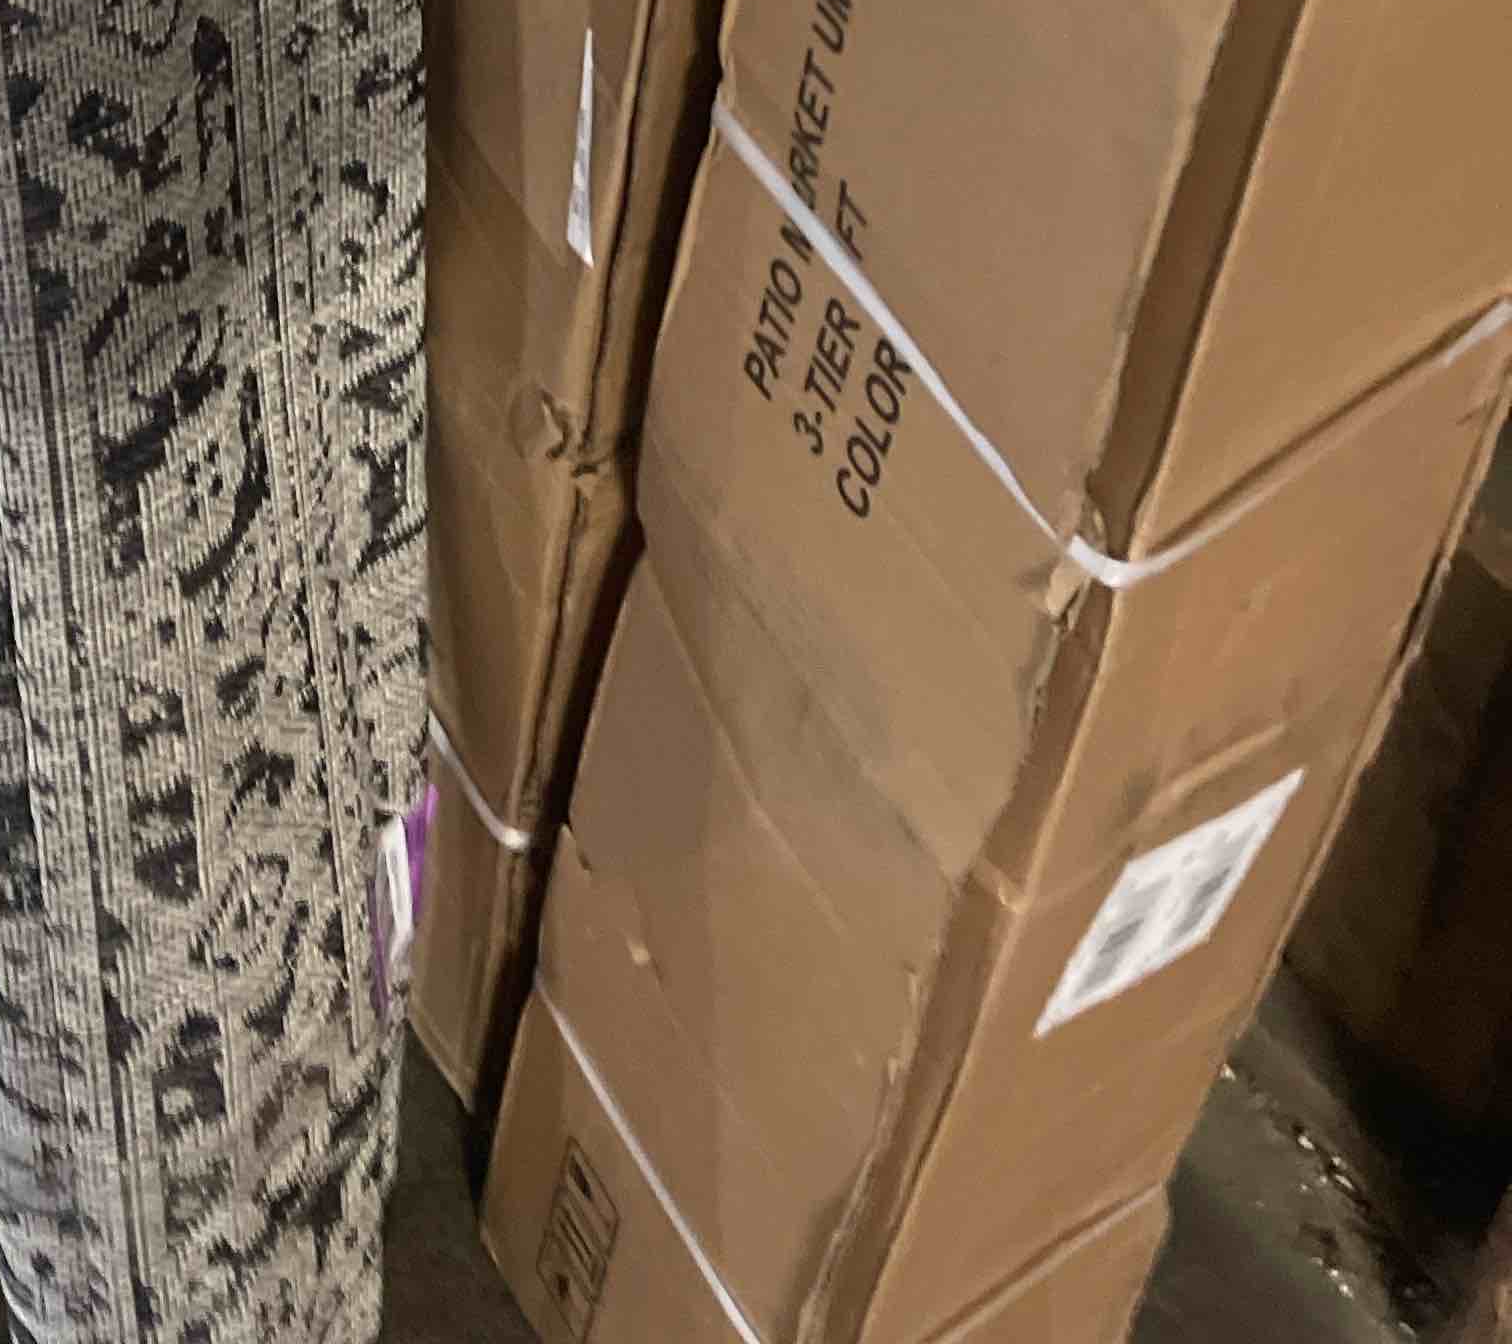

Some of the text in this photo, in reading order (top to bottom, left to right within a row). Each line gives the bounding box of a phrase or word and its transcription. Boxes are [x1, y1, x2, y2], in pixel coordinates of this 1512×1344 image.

[744, 258, 804, 400] PATIO
[779, 48, 836, 269] MRKET
[793, 297, 862, 456] 3-TIER
[836, 337, 914, 520] COLOR
